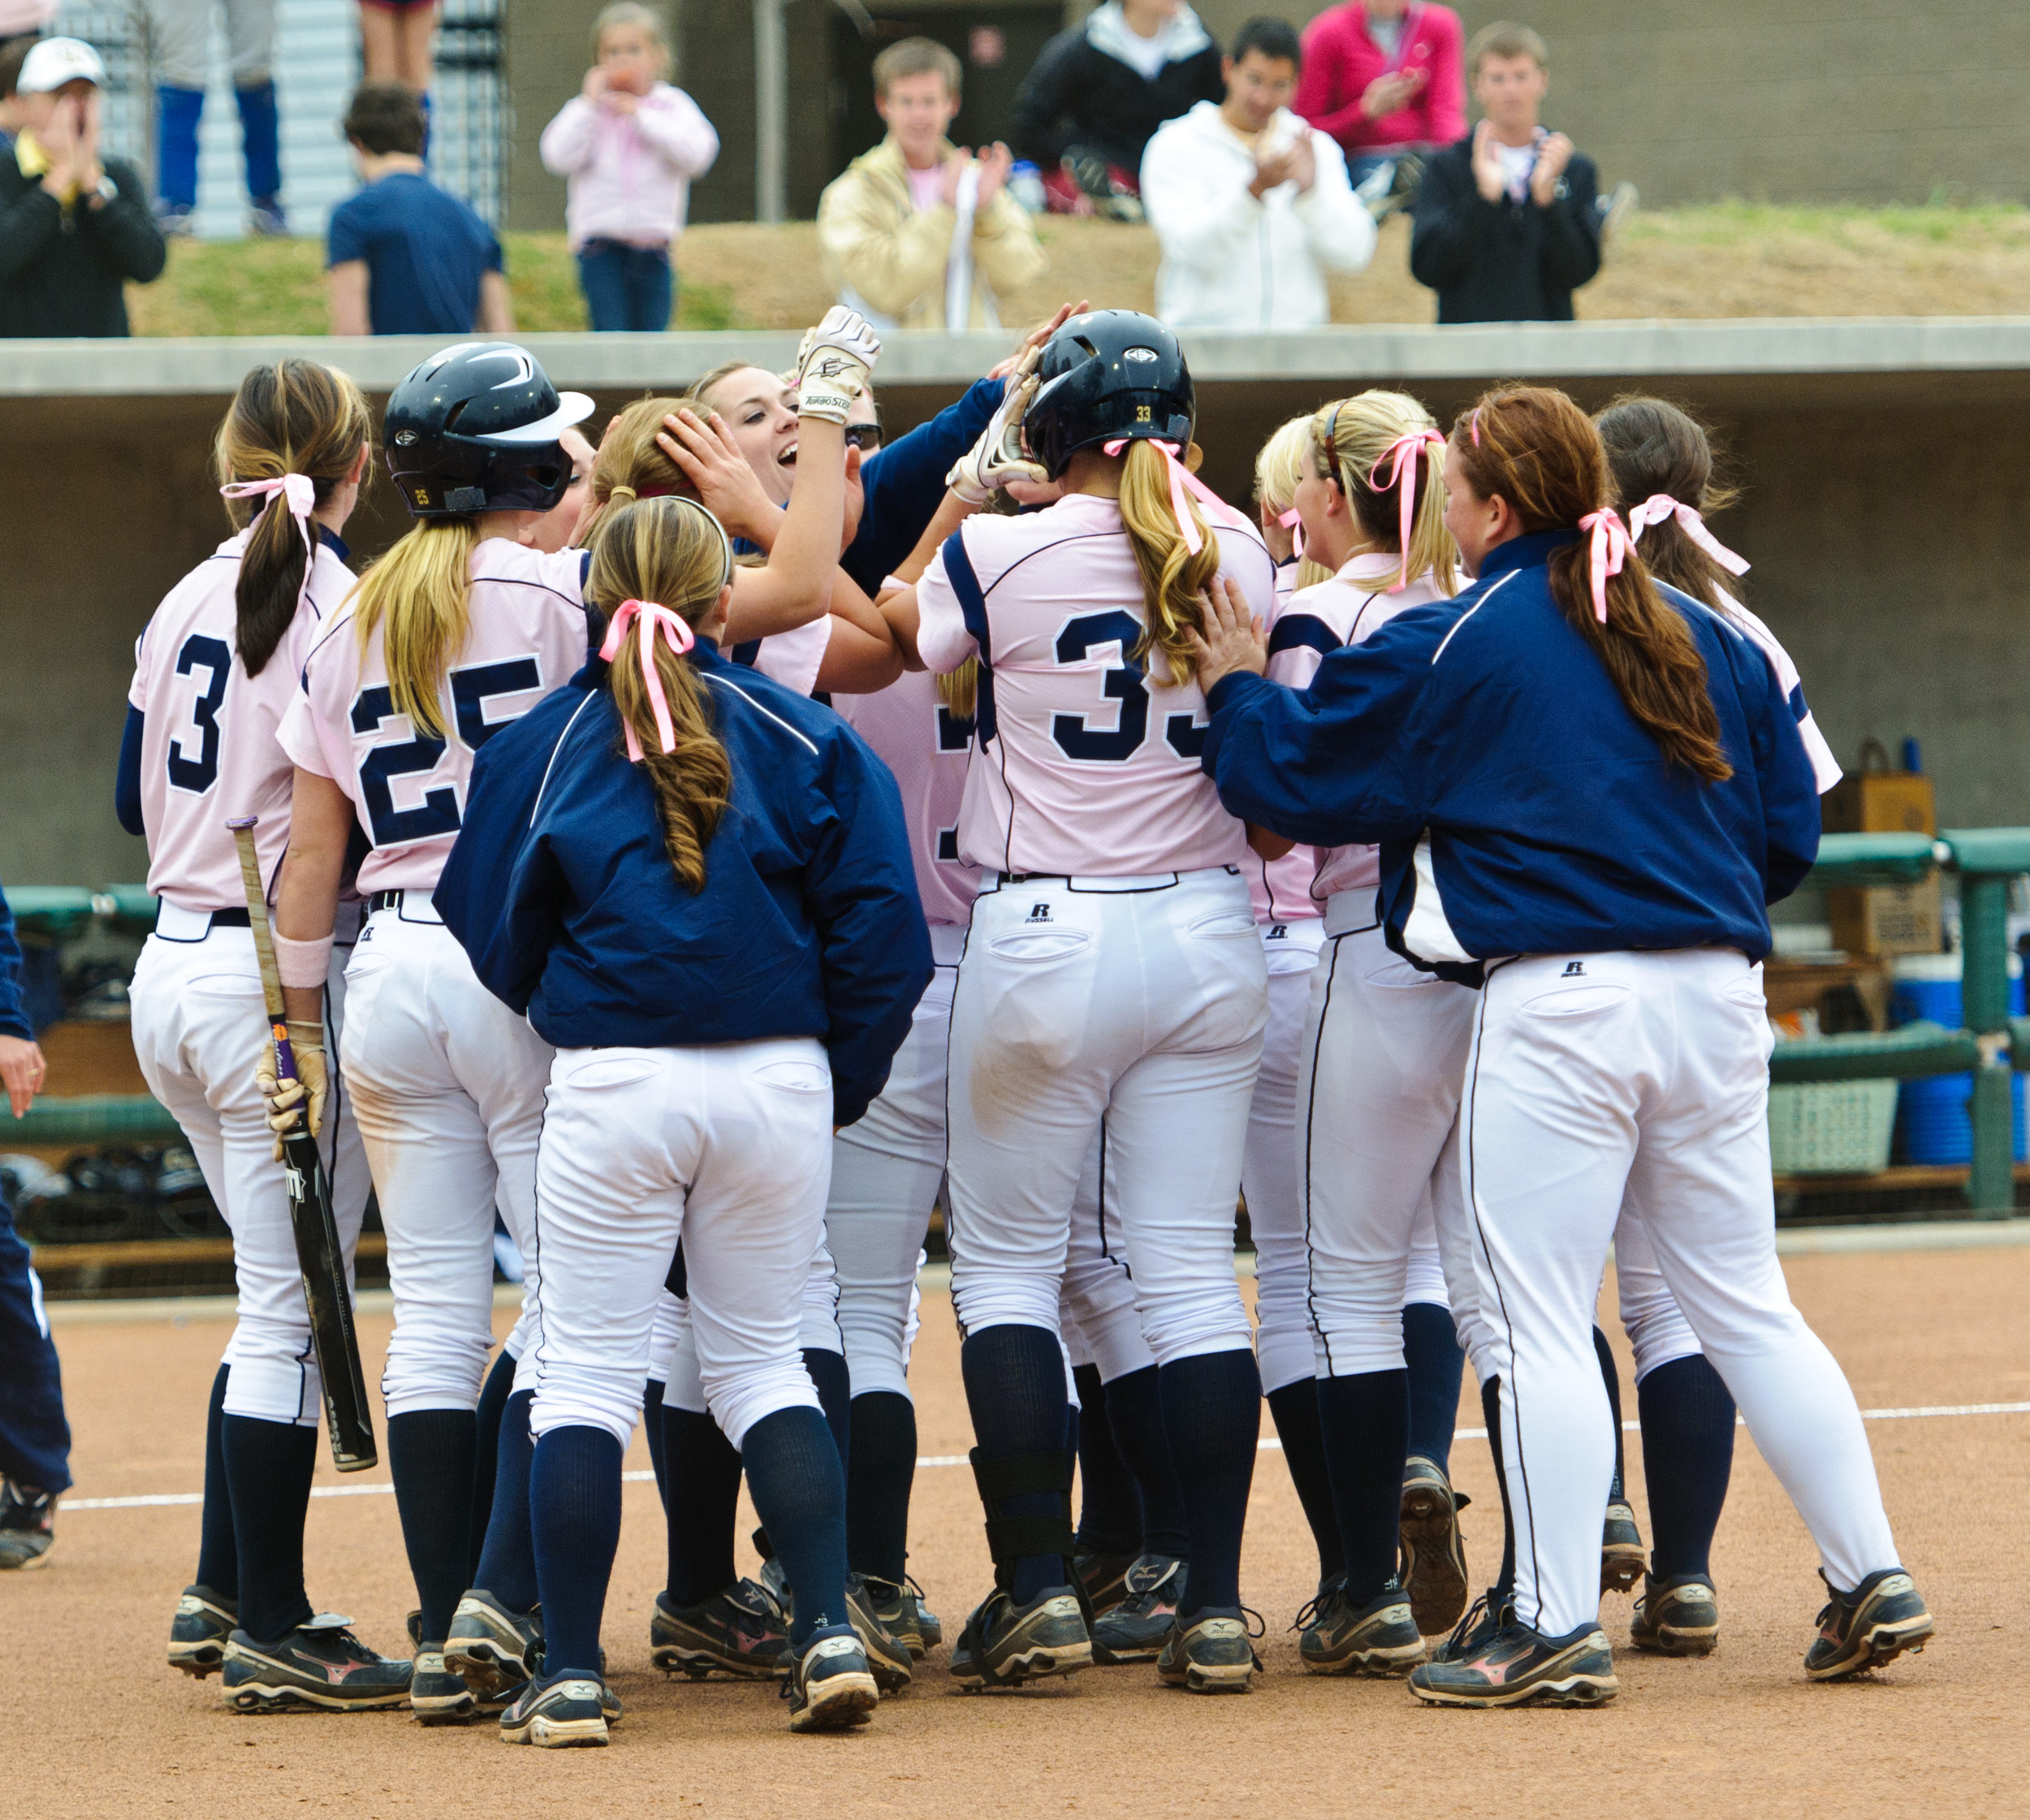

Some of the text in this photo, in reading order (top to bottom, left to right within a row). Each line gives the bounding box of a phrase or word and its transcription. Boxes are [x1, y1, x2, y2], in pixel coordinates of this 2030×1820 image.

[1136, 405, 1151, 422] 33
[415, 489, 430, 505] 25
[1052, 608, 1209, 763] 3
[167, 633, 233, 796] 3
[1030, 903, 1051, 918] R
[1566, 961, 1584, 973] R
